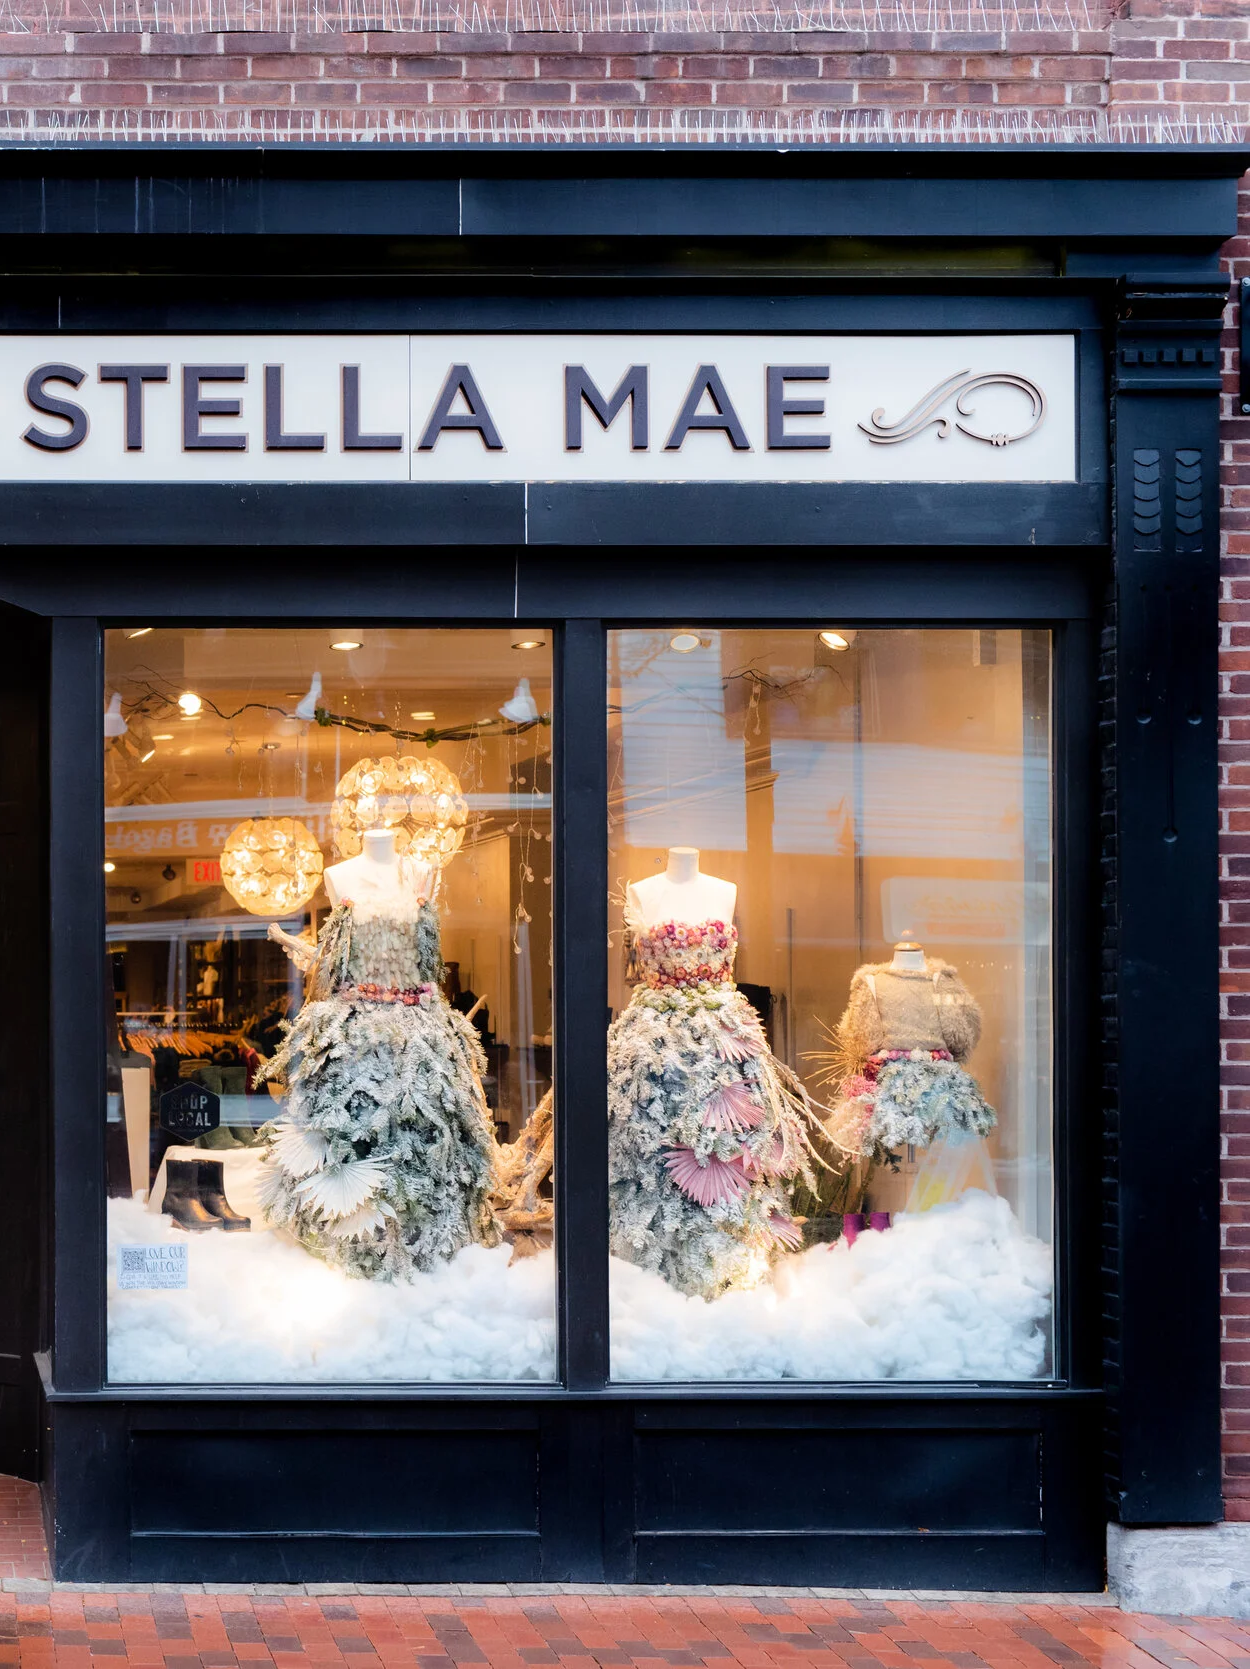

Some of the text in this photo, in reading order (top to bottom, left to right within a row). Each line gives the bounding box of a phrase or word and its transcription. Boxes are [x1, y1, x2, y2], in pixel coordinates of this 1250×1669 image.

[20, 361, 832, 454] STELLA MAE
[193, 861, 220, 883] EXIT
